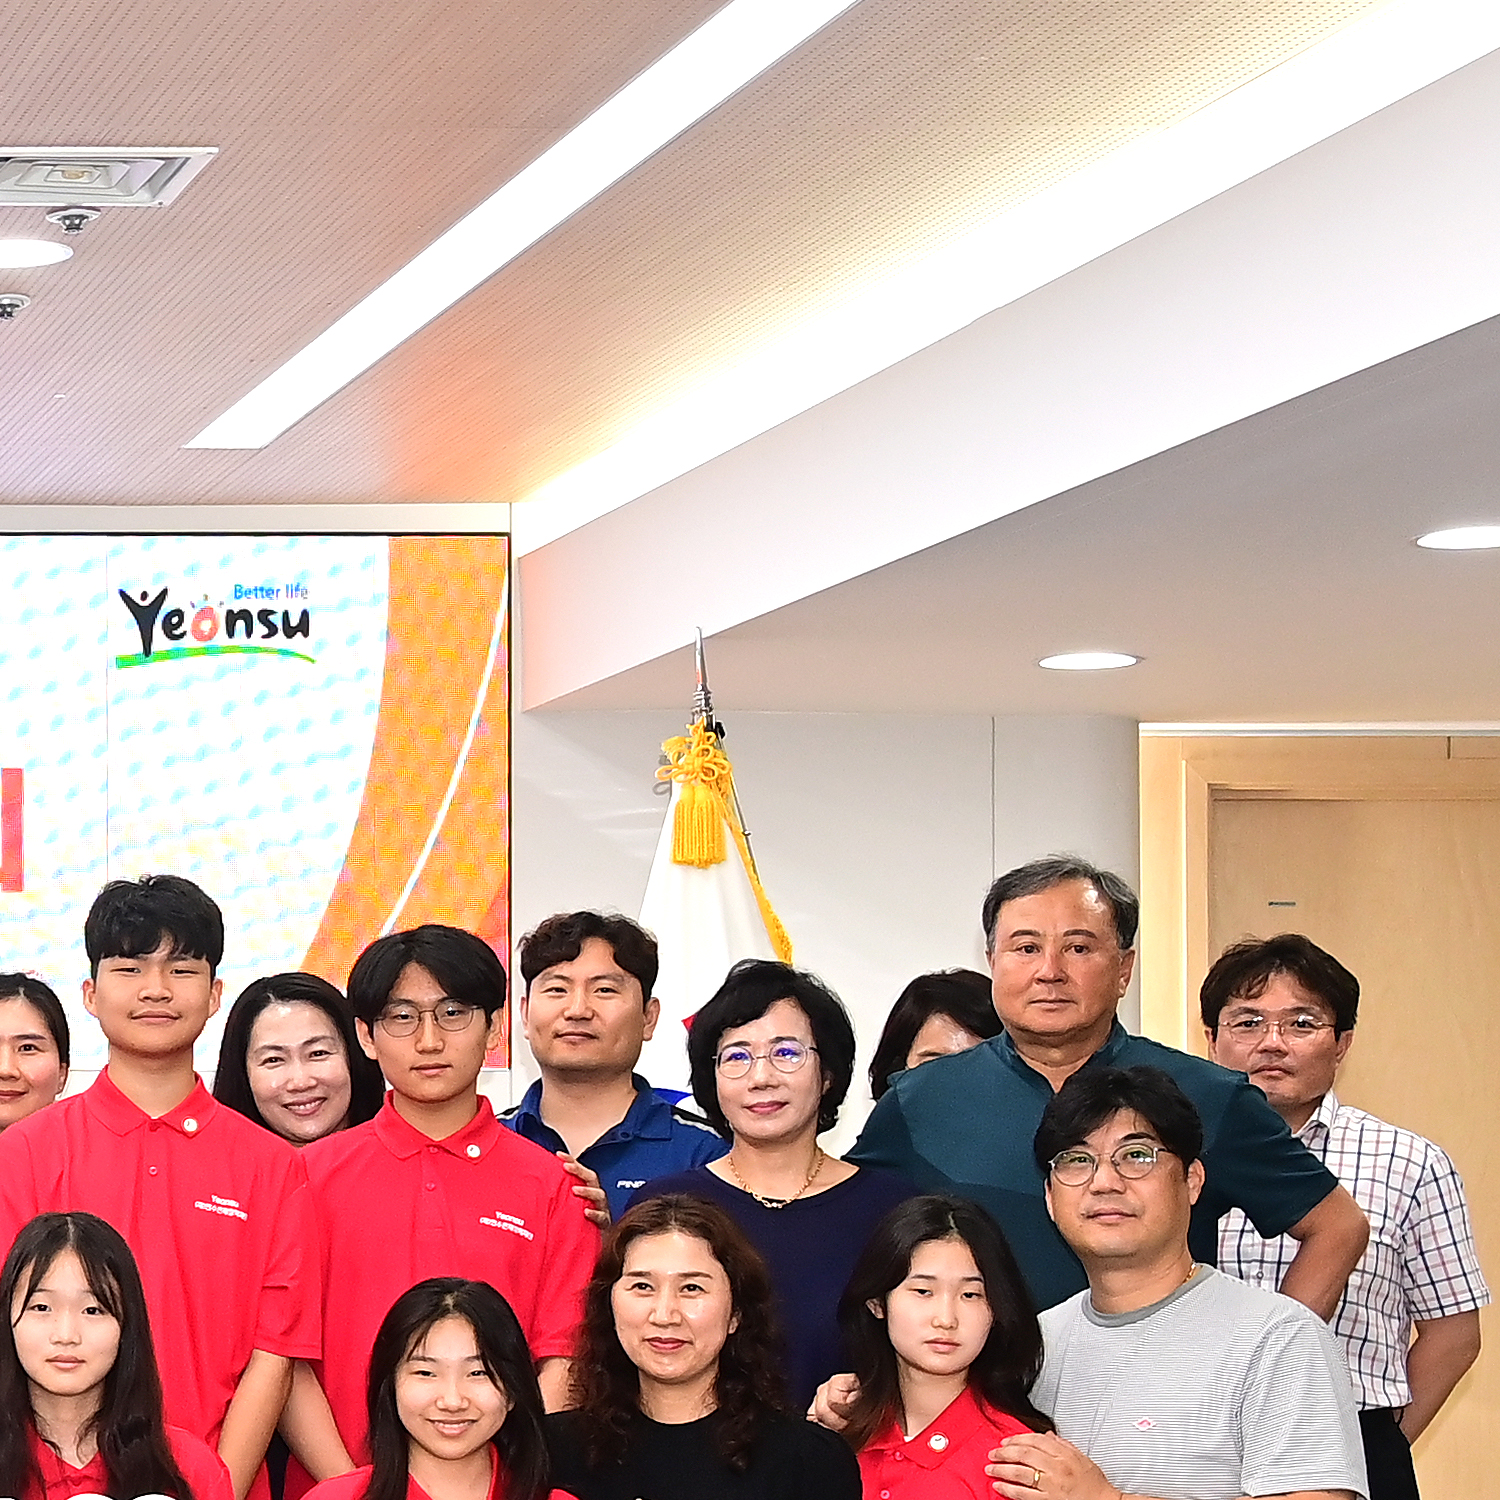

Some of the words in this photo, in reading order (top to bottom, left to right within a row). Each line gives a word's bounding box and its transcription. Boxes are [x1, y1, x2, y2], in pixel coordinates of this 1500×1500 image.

[234, 584, 281, 600] Better
[285, 583, 309, 600] life
[118, 586, 310, 657] Yeonsu
